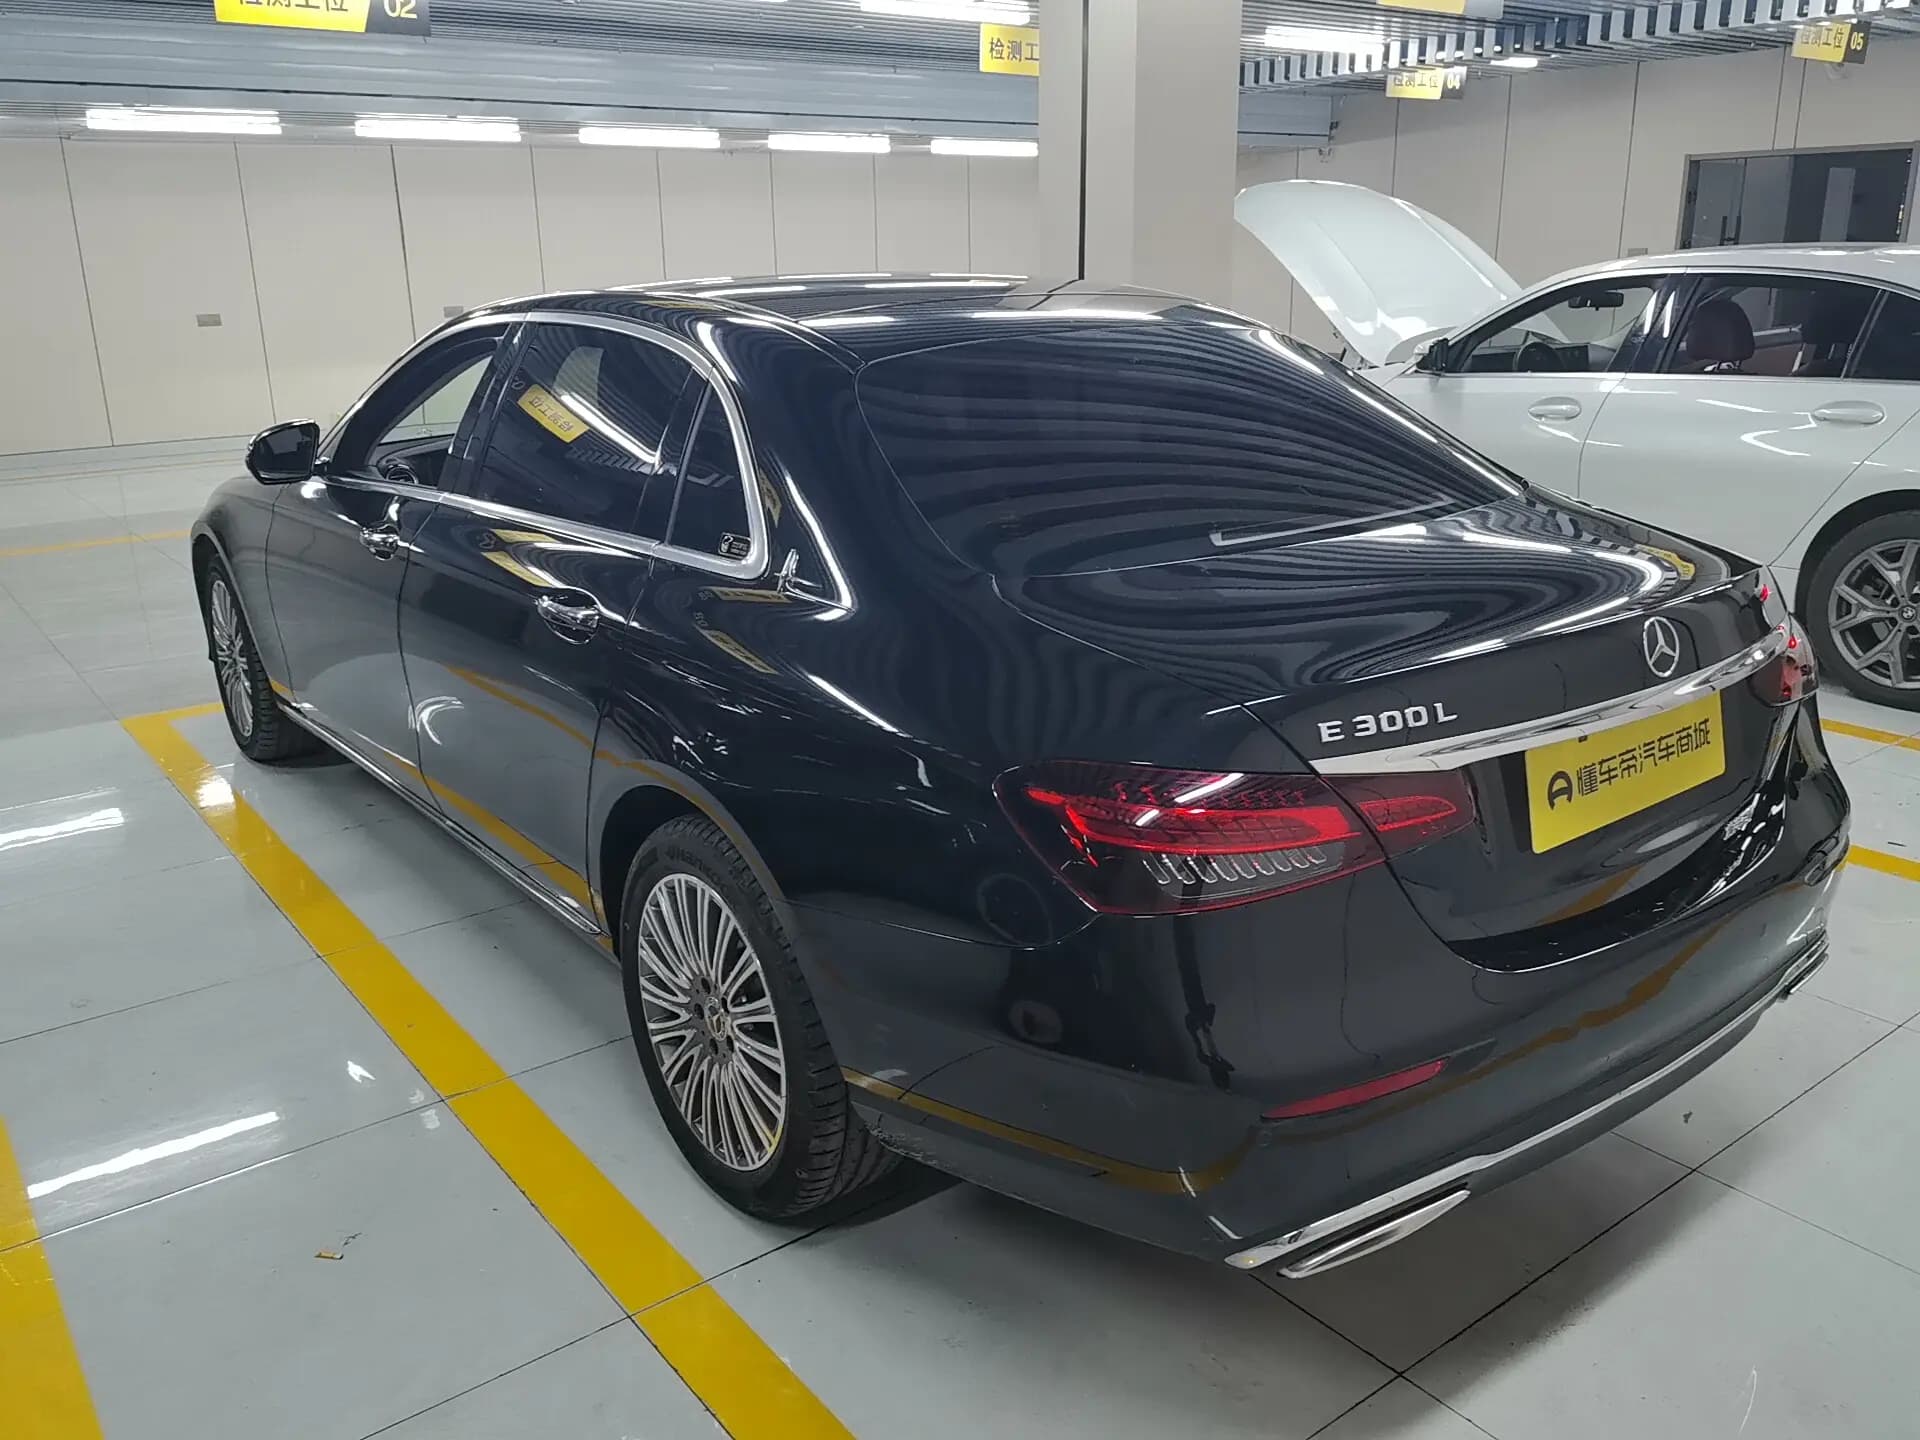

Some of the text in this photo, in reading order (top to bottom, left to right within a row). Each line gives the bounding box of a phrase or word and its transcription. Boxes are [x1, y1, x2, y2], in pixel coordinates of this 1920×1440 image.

[384, 0, 418, 19] 02
[1850, 32, 1864, 50] 05
[1446, 72, 1461, 90] 04
[1317, 720, 1345, 743] E
[1577, 717, 1711, 797] 懂车帝汽车商城
